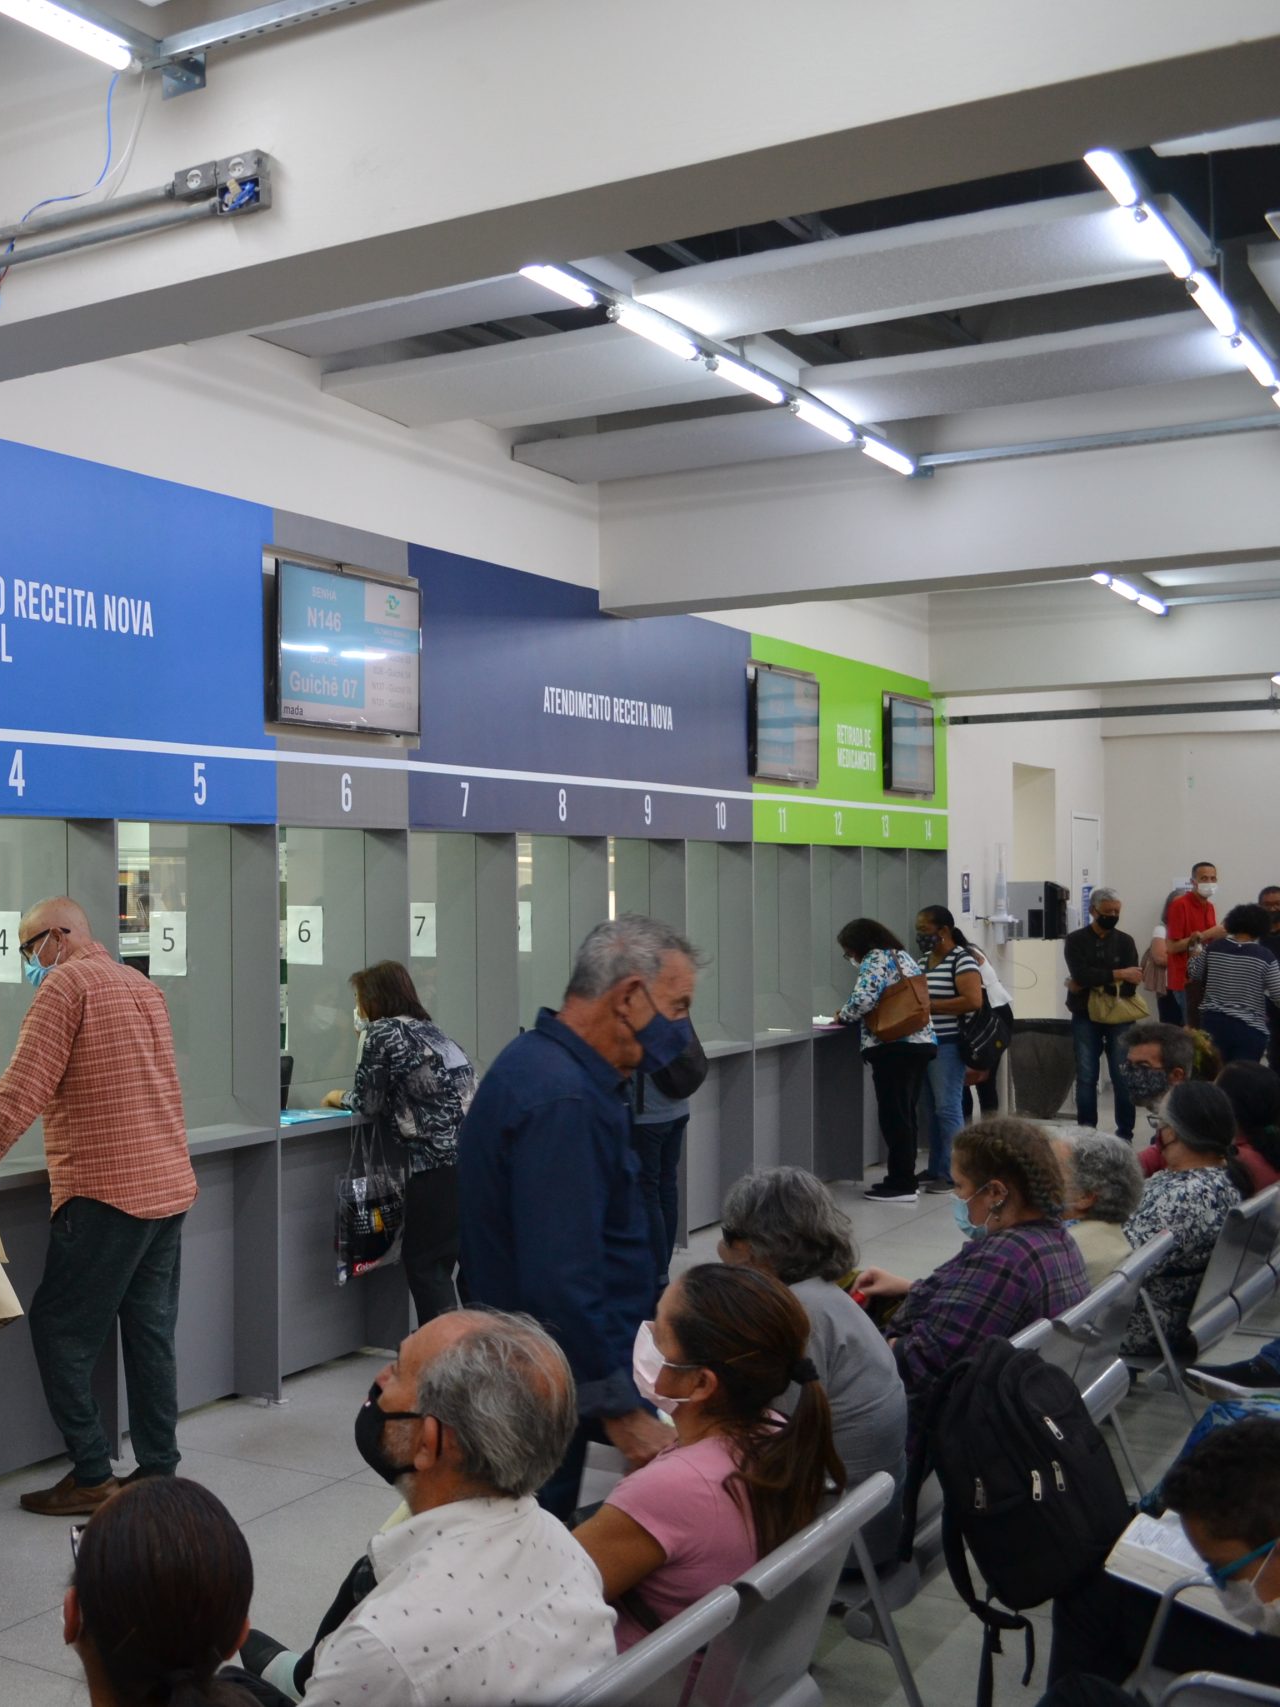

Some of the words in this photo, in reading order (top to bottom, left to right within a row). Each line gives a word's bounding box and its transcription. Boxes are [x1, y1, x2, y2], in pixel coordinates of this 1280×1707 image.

[13, 579, 97, 629] RECEITA
[104, 594, 154, 638] NOVA
[307, 606, 342, 632] N146
[342, 678, 358, 698] 07
[283, 705, 304, 716] mada
[543, 686, 611, 722] ATENDIMENTO
[613, 697, 649, 727] RECEITA
[650, 703, 673, 731] NOVA
[864, 728, 872, 749] DE
[837, 747, 877, 772] MEDICAMENTO
[8, 749, 26, 797] 4
[193, 762, 207, 805] 5
[341, 773, 352, 812] 6
[460, 782, 470, 817] 7
[558, 788, 567, 822] 8
[644, 794, 652, 825] 9
[715, 801, 727, 830] 10
[778, 807, 787, 833] 11
[834, 811, 843, 836] 12
[881, 814, 889, 838] 13
[924, 819, 932, 840] 14
[298, 920, 311, 943] 6
[414, 915, 426, 937] 7
[162, 927, 175, 953] 5
